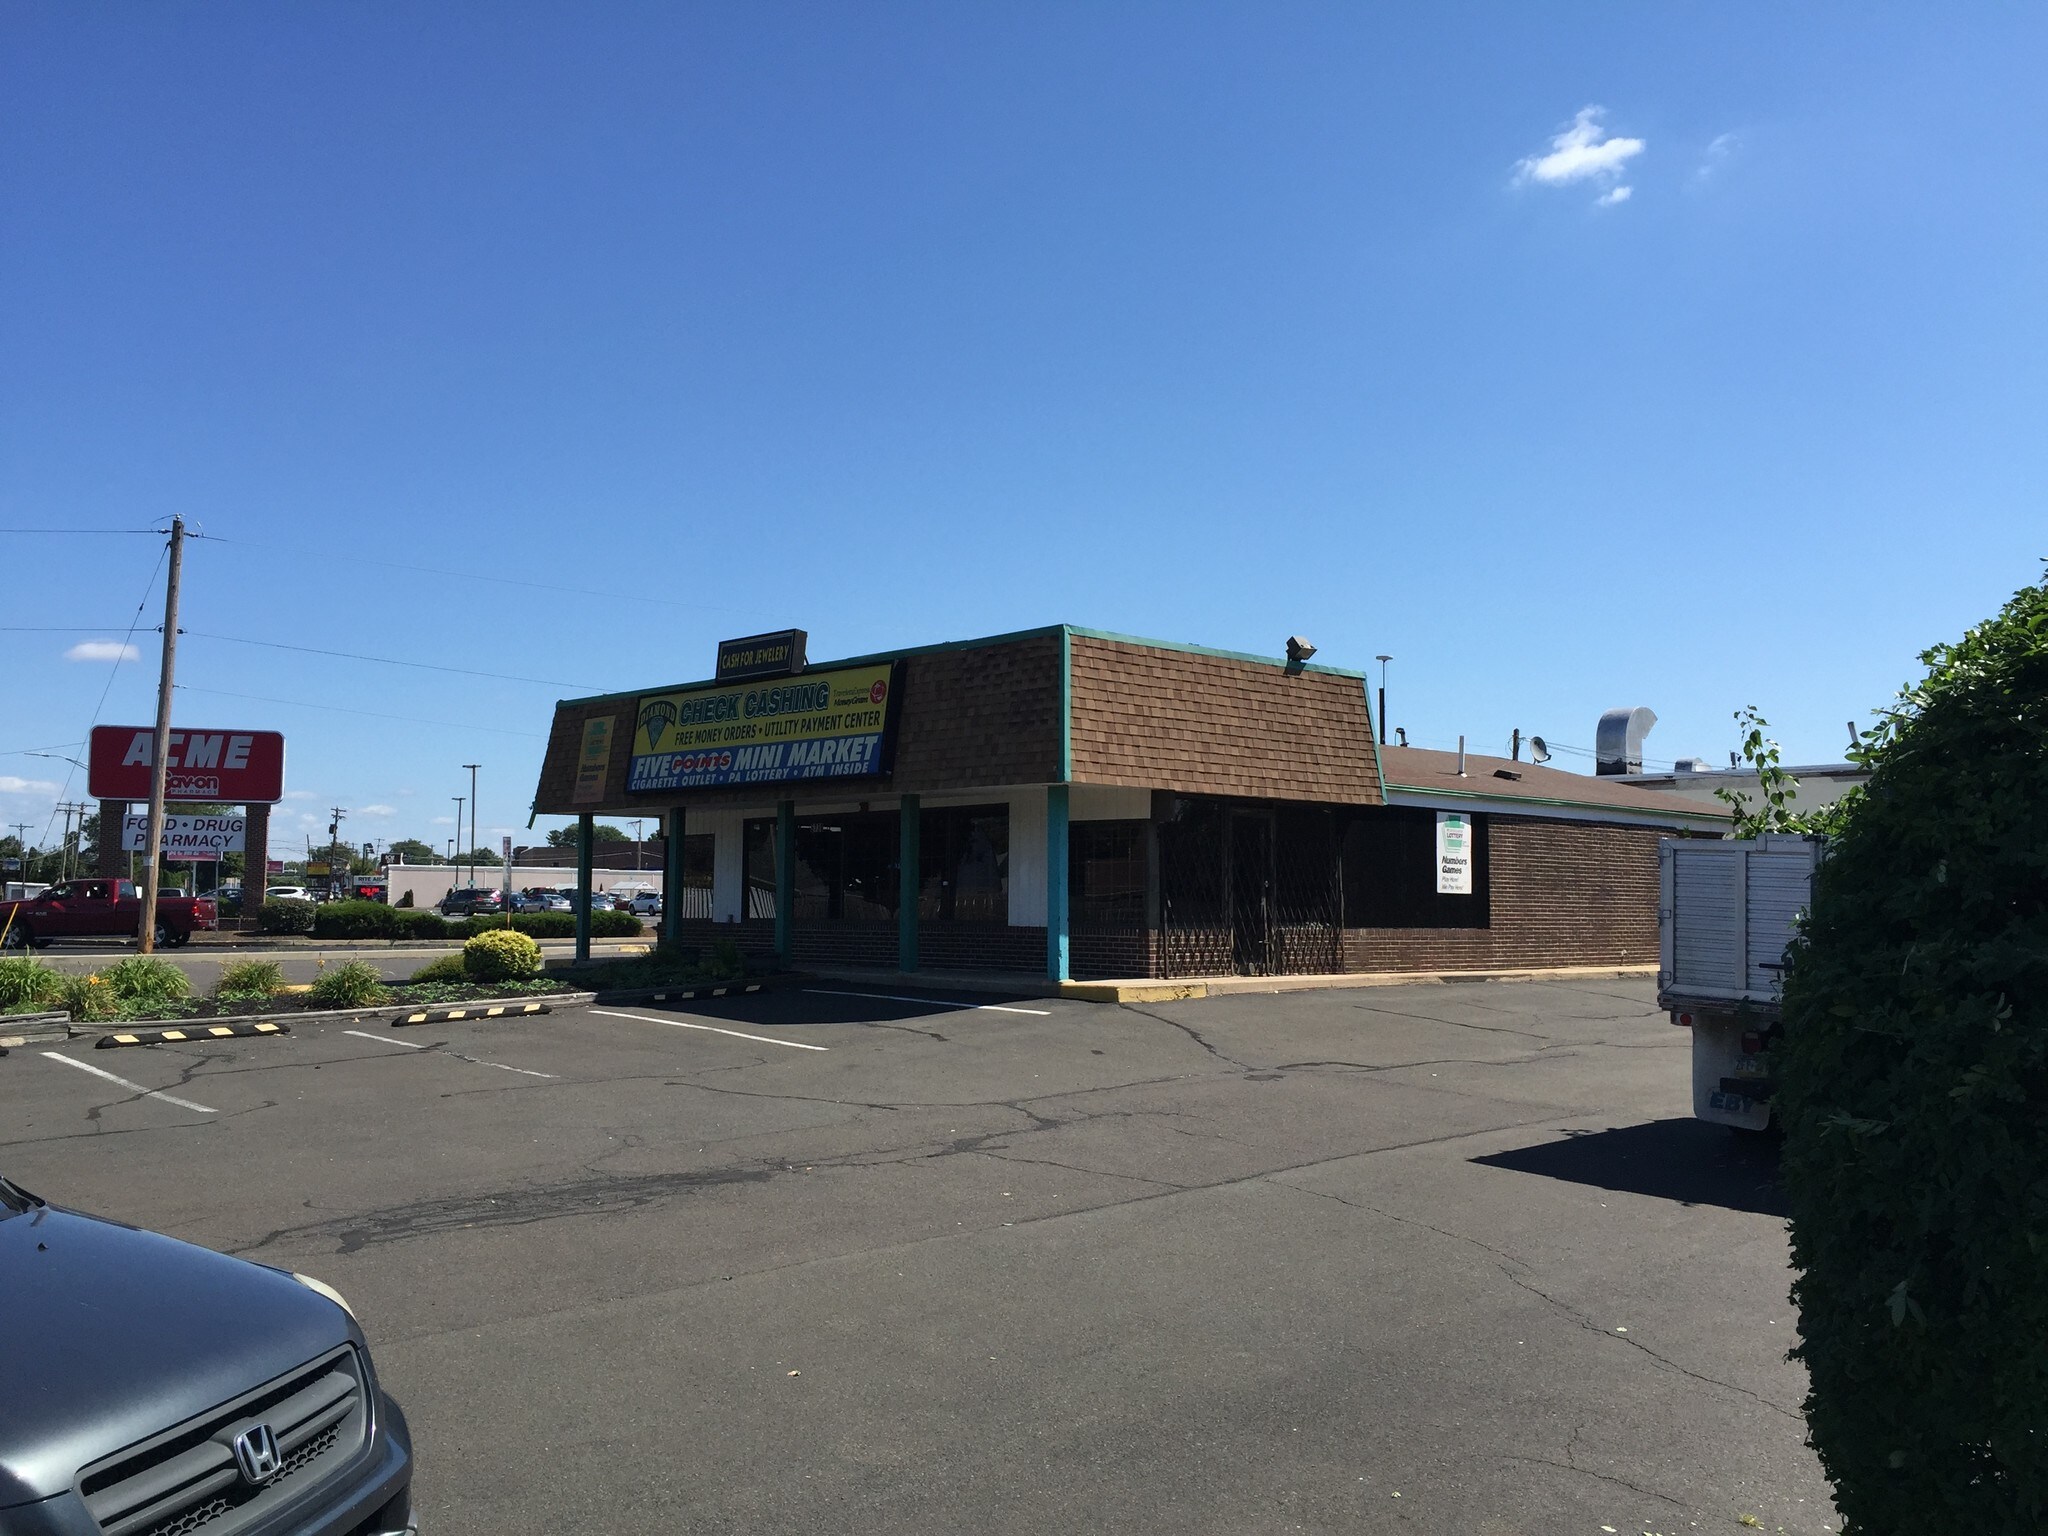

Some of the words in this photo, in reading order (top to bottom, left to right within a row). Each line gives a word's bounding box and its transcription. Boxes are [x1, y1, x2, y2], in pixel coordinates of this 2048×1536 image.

[722, 653, 740, 669] CASH
[739, 650, 754, 667] FOR
[754, 644, 790, 665] JEWELERY
[640, 703, 676, 724] DIAMOND
[680, 693, 743, 727] CHECK
[743, 681, 830, 719] CASHING
[675, 731, 694, 746] FREE
[694, 727, 724, 744] MONEY
[724, 724, 757, 741] ORDERS
[764, 718, 800, 737] UTILITY
[800, 714, 843, 734] PAYMENT
[844, 710, 881, 729] CENTER
[633, 755, 672, 779] FIVE
[672, 755, 731, 771] POINTS
[733, 744, 785, 771] MINI
[787, 735, 880, 767] MARKET
[631, 777, 678, 790] CIGARETTE
[681, 774, 717, 786] OUTLET
[728, 772, 741, 783] PA
[745, 767, 790, 782] LOTTERY
[802, 765, 825, 778] ATM
[830, 761, 869, 776] INSIDE
[126, 818, 177, 832] FOD
[193, 820, 243, 832] DRUG
[134, 834, 233, 848] PARMACY
[1441, 856, 1468, 866] Numbers
[1441, 865, 1462, 874] Games
